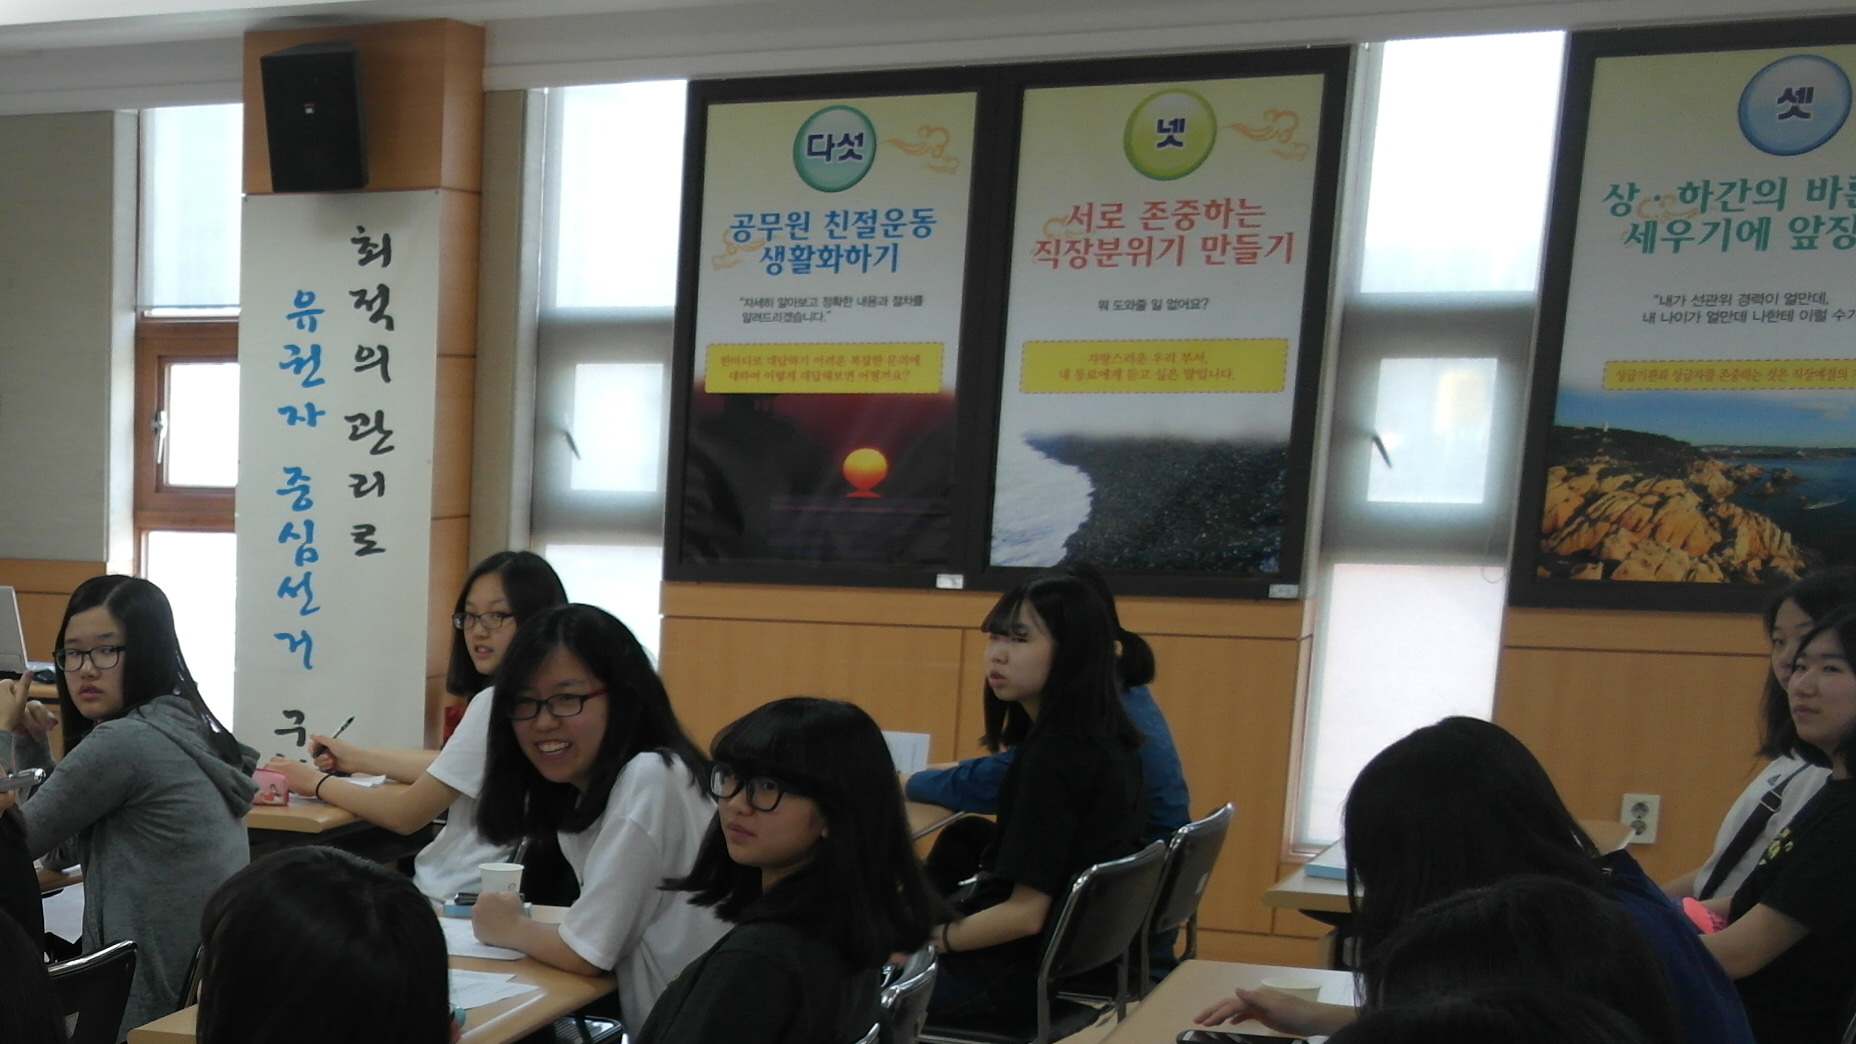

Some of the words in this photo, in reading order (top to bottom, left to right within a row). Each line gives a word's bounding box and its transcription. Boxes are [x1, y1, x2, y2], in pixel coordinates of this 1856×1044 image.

[1776, 86, 1814, 120] 셋
[806, 132, 865, 162] 다섯
[1156, 118, 1186, 148] 넷
[729, 210, 810, 243] 공무원
[824, 208, 937, 240] 친절운동
[1065, 202, 1125, 234] 서로
[1138, 198, 1266, 232] 존중하는
[1033, 234, 1185, 270] 직장분위기
[1200, 232, 1294, 266] 만들기
[1623, 216, 1772, 254] 세우기에
[760, 242, 899, 276] 생활화하기
[1151, 299, 1162, 311] 일
[1642, 311, 1656, 324] 내
[1660, 310, 1702, 324] 나이가
[1752, 309, 1795, 323] 나한테
[1691, 293, 1732, 307] 선관위
[278, 289, 326, 428] 유권자
[274, 709, 307, 763] 구
